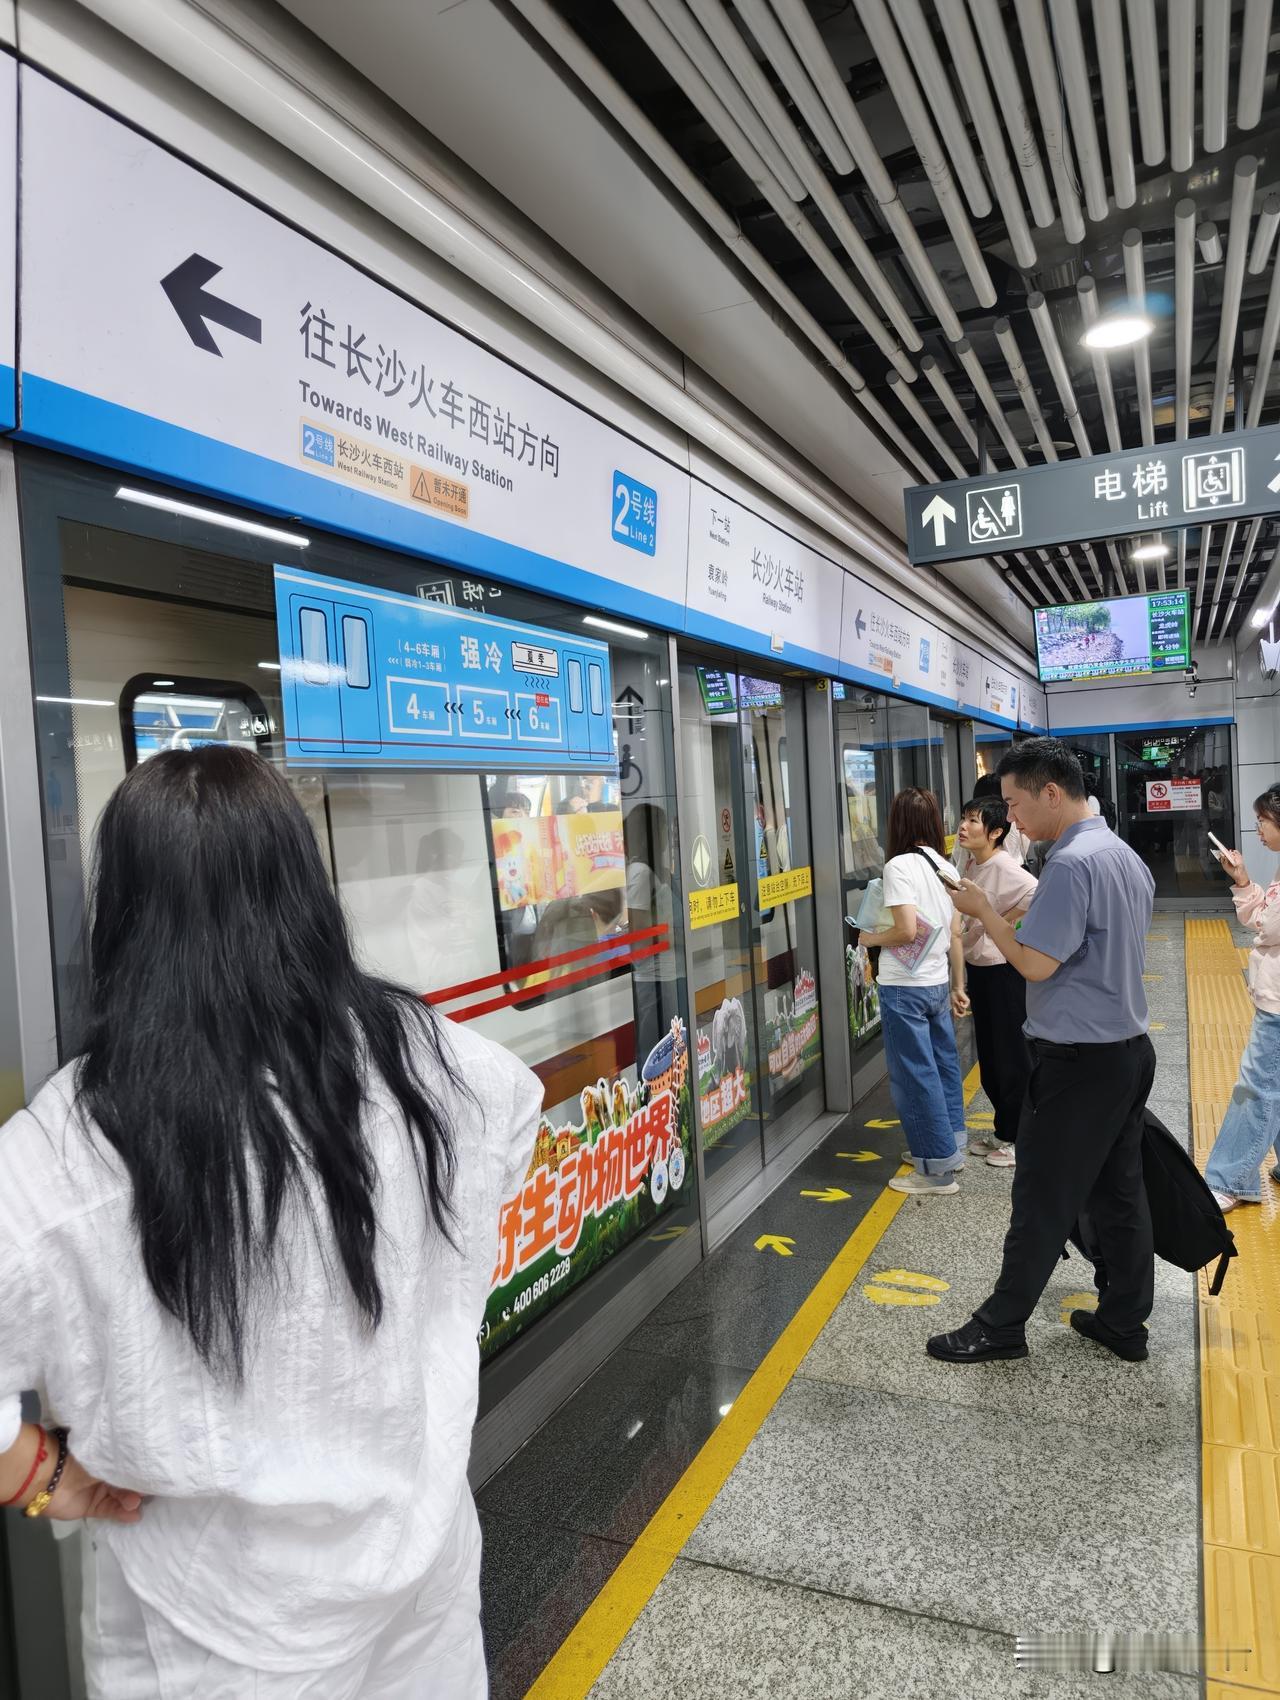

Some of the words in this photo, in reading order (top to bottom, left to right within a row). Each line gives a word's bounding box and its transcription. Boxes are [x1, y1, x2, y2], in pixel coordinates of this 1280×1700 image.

[299, 301, 560, 478] 往长沙火车西站方向
[299, 379, 372, 431] Towards
[376, 415, 414, 450] West
[418, 434, 468, 476] Railway
[471, 459, 513, 493] Station
[337, 460, 353, 473] West
[353, 466, 377, 483] Railway
[378, 474, 398, 490] Station
[338, 438, 404, 480] 长沙火车西站
[434, 478, 467, 504] 暂未开通
[1094, 460, 1169, 501] 电梯
[614, 481, 656, 538] 2号线
[710, 508, 731, 533] 下一站
[1137, 501, 1169, 521] Lift
[629, 526, 646, 543] Line
[647, 532, 654, 548] 2
[751, 546, 804, 603] 长沙火车站
[1152, 598, 1183, 607] 17:53:14
[460, 635, 503, 673] 强冷
[526, 650, 545, 666] 夏季
[819, 680, 826, 690] 3
[513, 1287, 531, 1313] 400
[532, 1273, 549, 1300] 606
[549, 1256, 570, 1287] 2229
